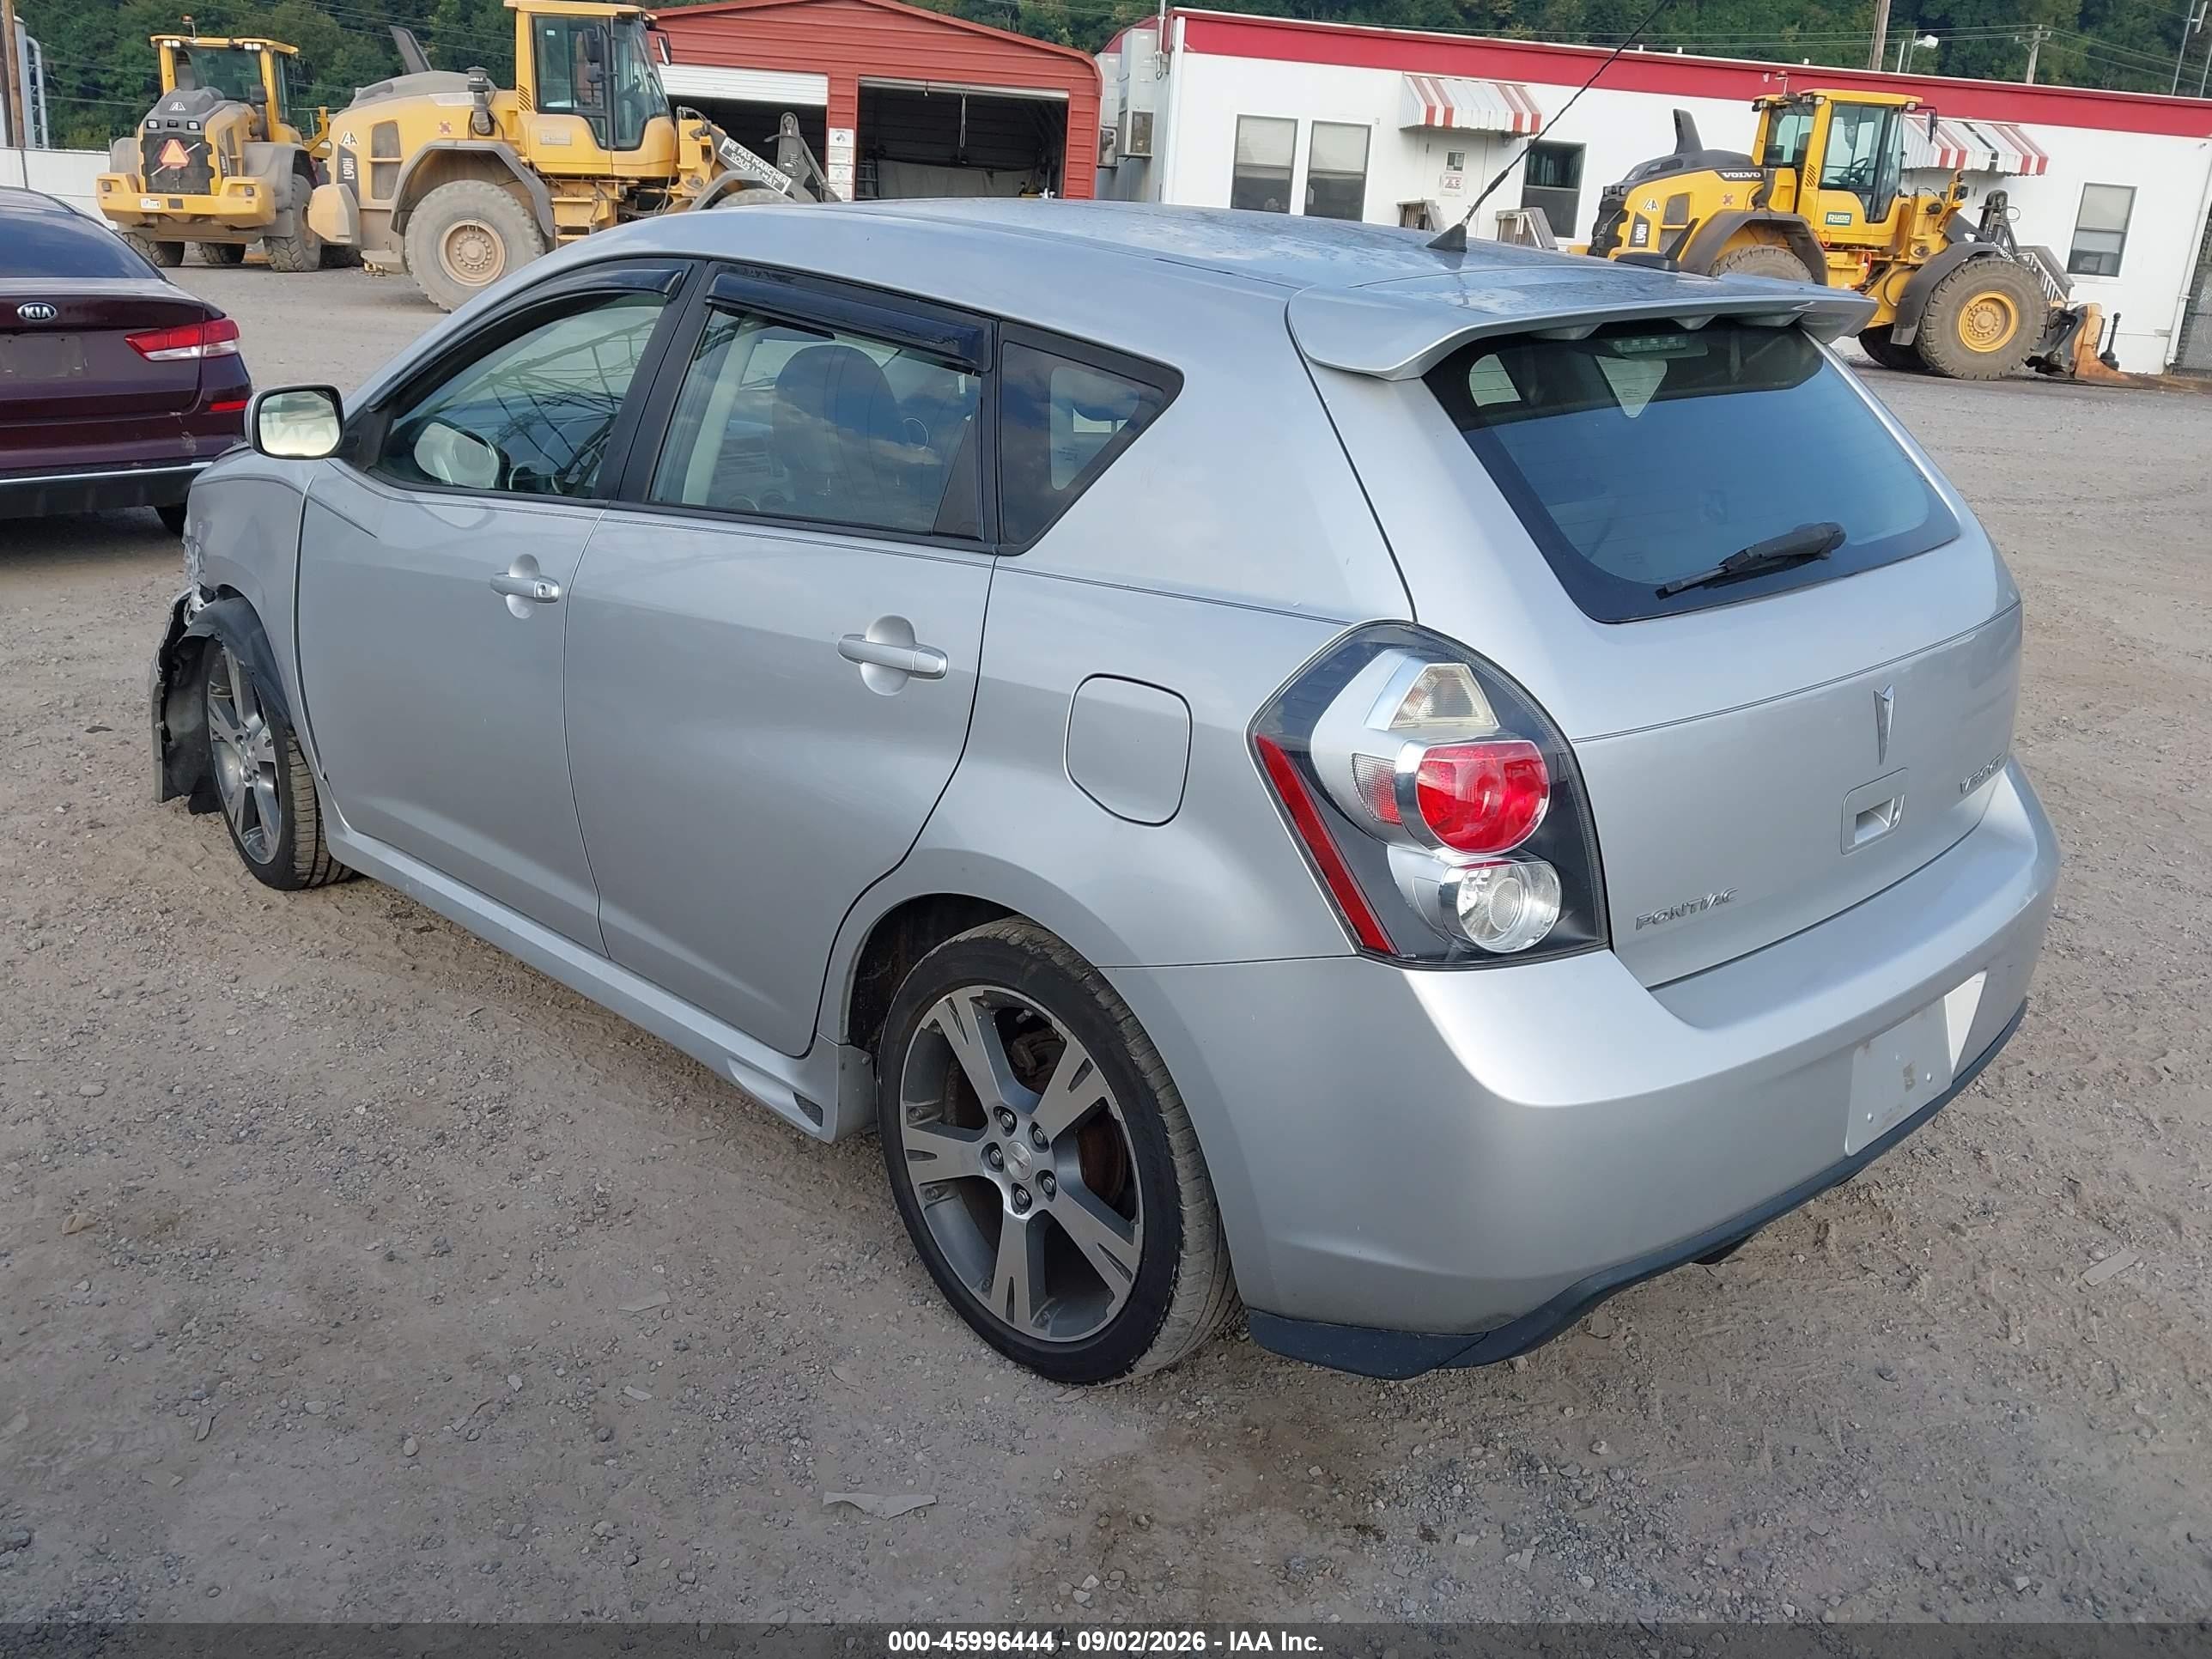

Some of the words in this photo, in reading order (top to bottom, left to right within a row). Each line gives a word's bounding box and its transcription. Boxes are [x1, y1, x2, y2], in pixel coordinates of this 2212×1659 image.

[342, 157, 356, 179] L90H
[727, 140, 738, 152] NE
[737, 147, 752, 161] PAS
[751, 157, 788, 185] MARCHER
[730, 152, 752, 170] SOUS
[1635, 223, 1648, 244] L90H
[23, 306, 52, 319] KIA
[1635, 887, 1739, 931] PONTIAC
